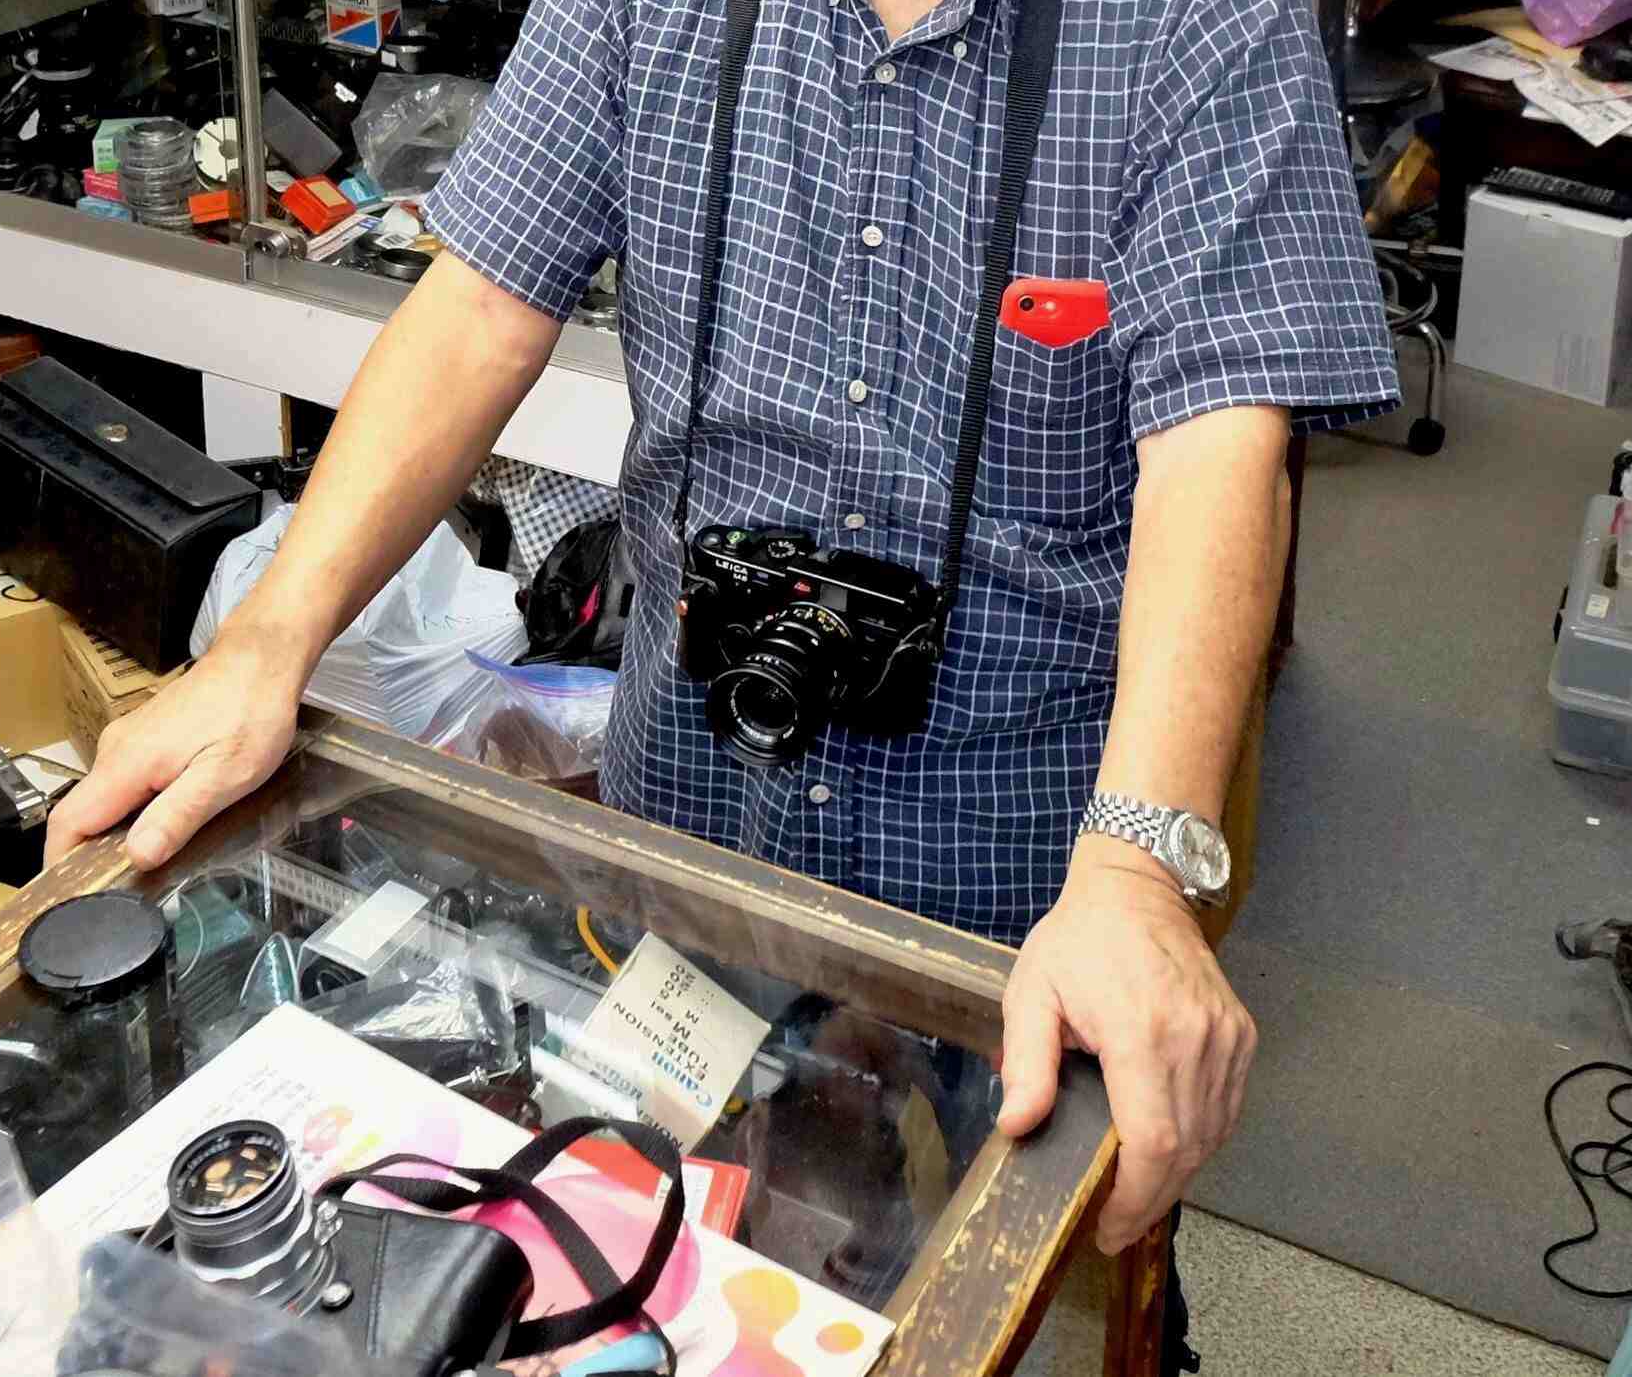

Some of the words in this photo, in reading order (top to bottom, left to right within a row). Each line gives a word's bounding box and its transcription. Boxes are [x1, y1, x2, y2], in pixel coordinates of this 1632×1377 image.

[715, 559, 748, 576] LEICA
[612, 1001, 707, 1082] EXTENSION
[672, 1021, 692, 1040] M
[666, 1033, 710, 1071] TUBE
[651, 1050, 714, 1108] Canon
